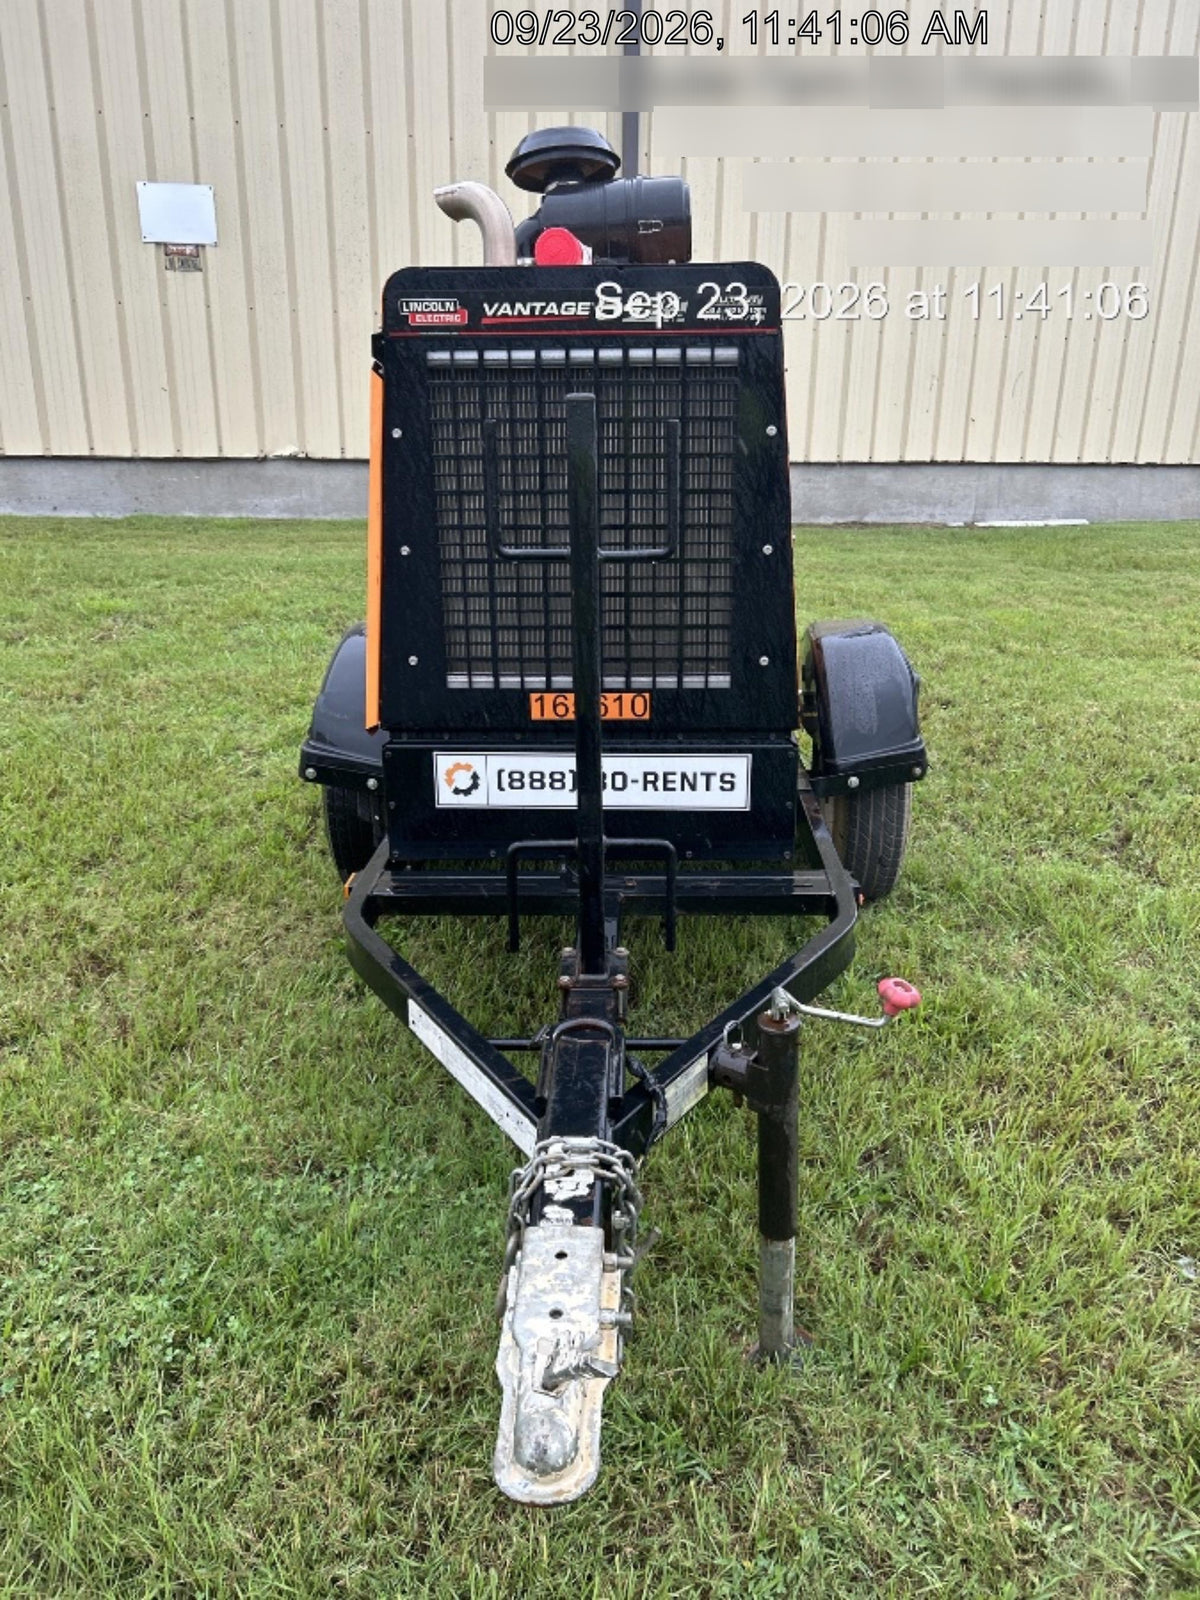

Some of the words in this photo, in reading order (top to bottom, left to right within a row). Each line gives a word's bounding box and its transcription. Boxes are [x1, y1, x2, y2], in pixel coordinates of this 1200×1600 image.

[402, 301, 455, 313] LINCOLN
[483, 302, 592, 316] VANTAGE
[415, 313, 462, 323] ELECTRIC
[534, 693, 648, 718] 16610
